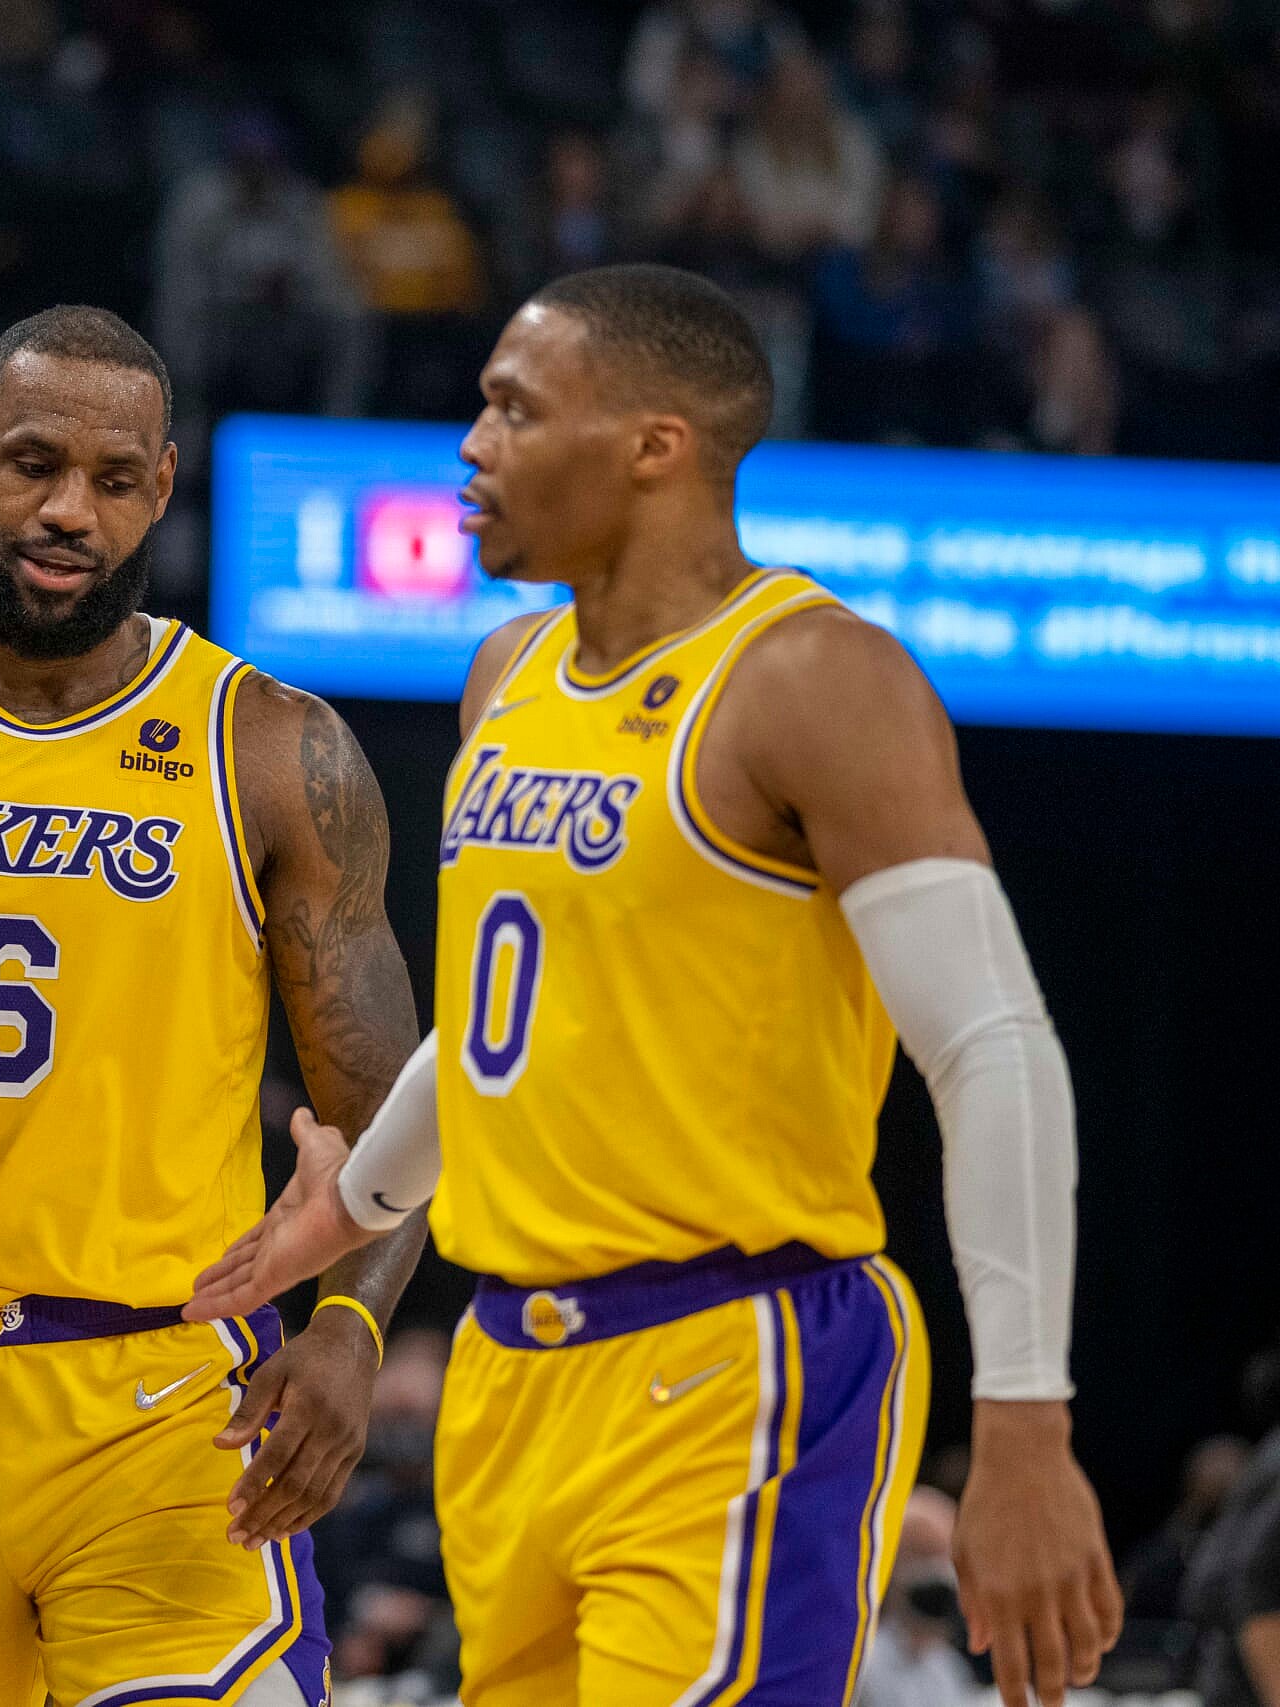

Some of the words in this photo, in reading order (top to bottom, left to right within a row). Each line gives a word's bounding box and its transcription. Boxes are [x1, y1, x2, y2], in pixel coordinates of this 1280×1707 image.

[120, 750, 195, 782] bibigo
[439, 744, 643, 876] LAKERS
[460, 889, 545, 1098] 0
